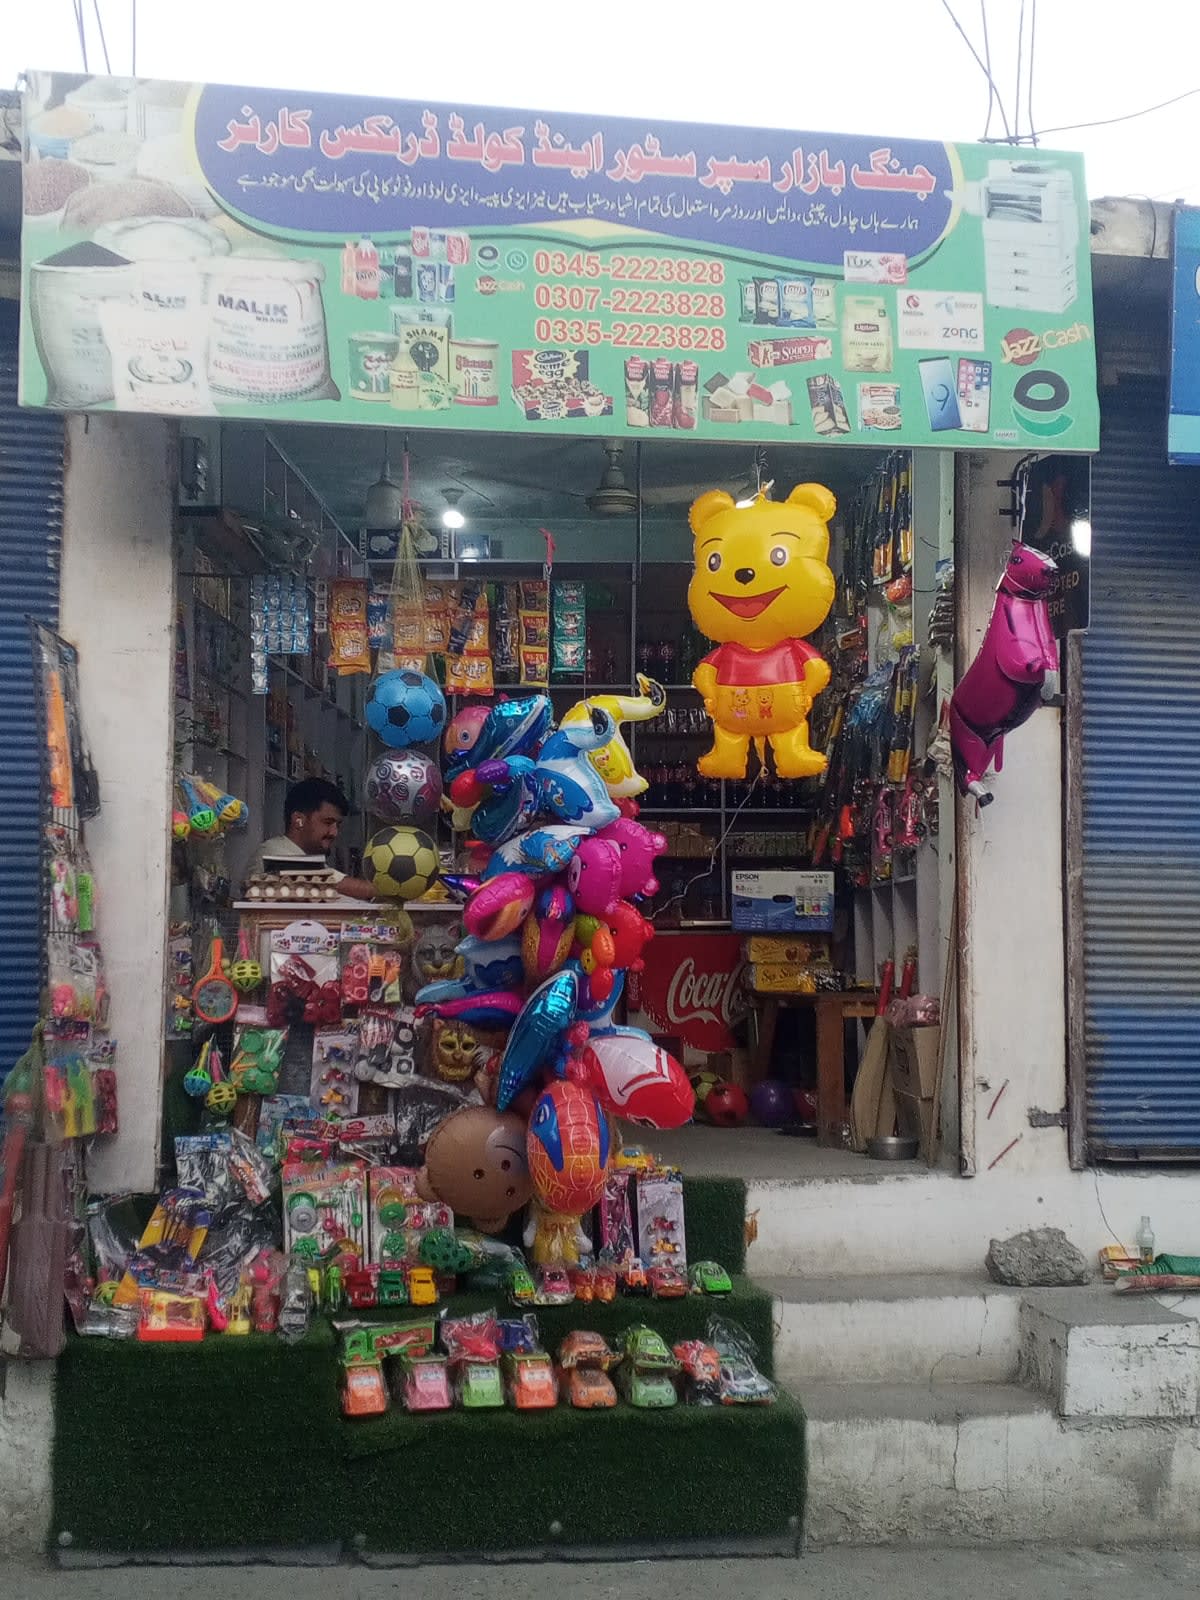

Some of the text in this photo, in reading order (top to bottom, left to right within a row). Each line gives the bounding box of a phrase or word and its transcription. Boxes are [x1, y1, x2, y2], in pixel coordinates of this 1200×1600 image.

[217, 104, 937, 201] جنگ بازار سپر سٹور اینڈ کولڈ ڈرنکس کارنر
[546, 191, 568, 214] ہیں
[567, 192, 610, 214] دستیاب
[636, 195, 661, 222] تمام
[659, 192, 676, 218] کی
[672, 194, 713, 219] استعمال
[766, 196, 796, 224] دالیں
[860, 210, 879, 235] ہاں
[880, 214, 919, 231] ہمارے
[534, 251, 725, 285] 0345-2223828
[217, 293, 288, 317] MALIK
[535, 284, 726, 317] 0307-2223828
[405, 327, 445, 343] SHAMA
[535, 317, 727, 350] 0335-2223828
[1000, 321, 1091, 365] Jazz Cash
[538, 368, 565, 378] egg
